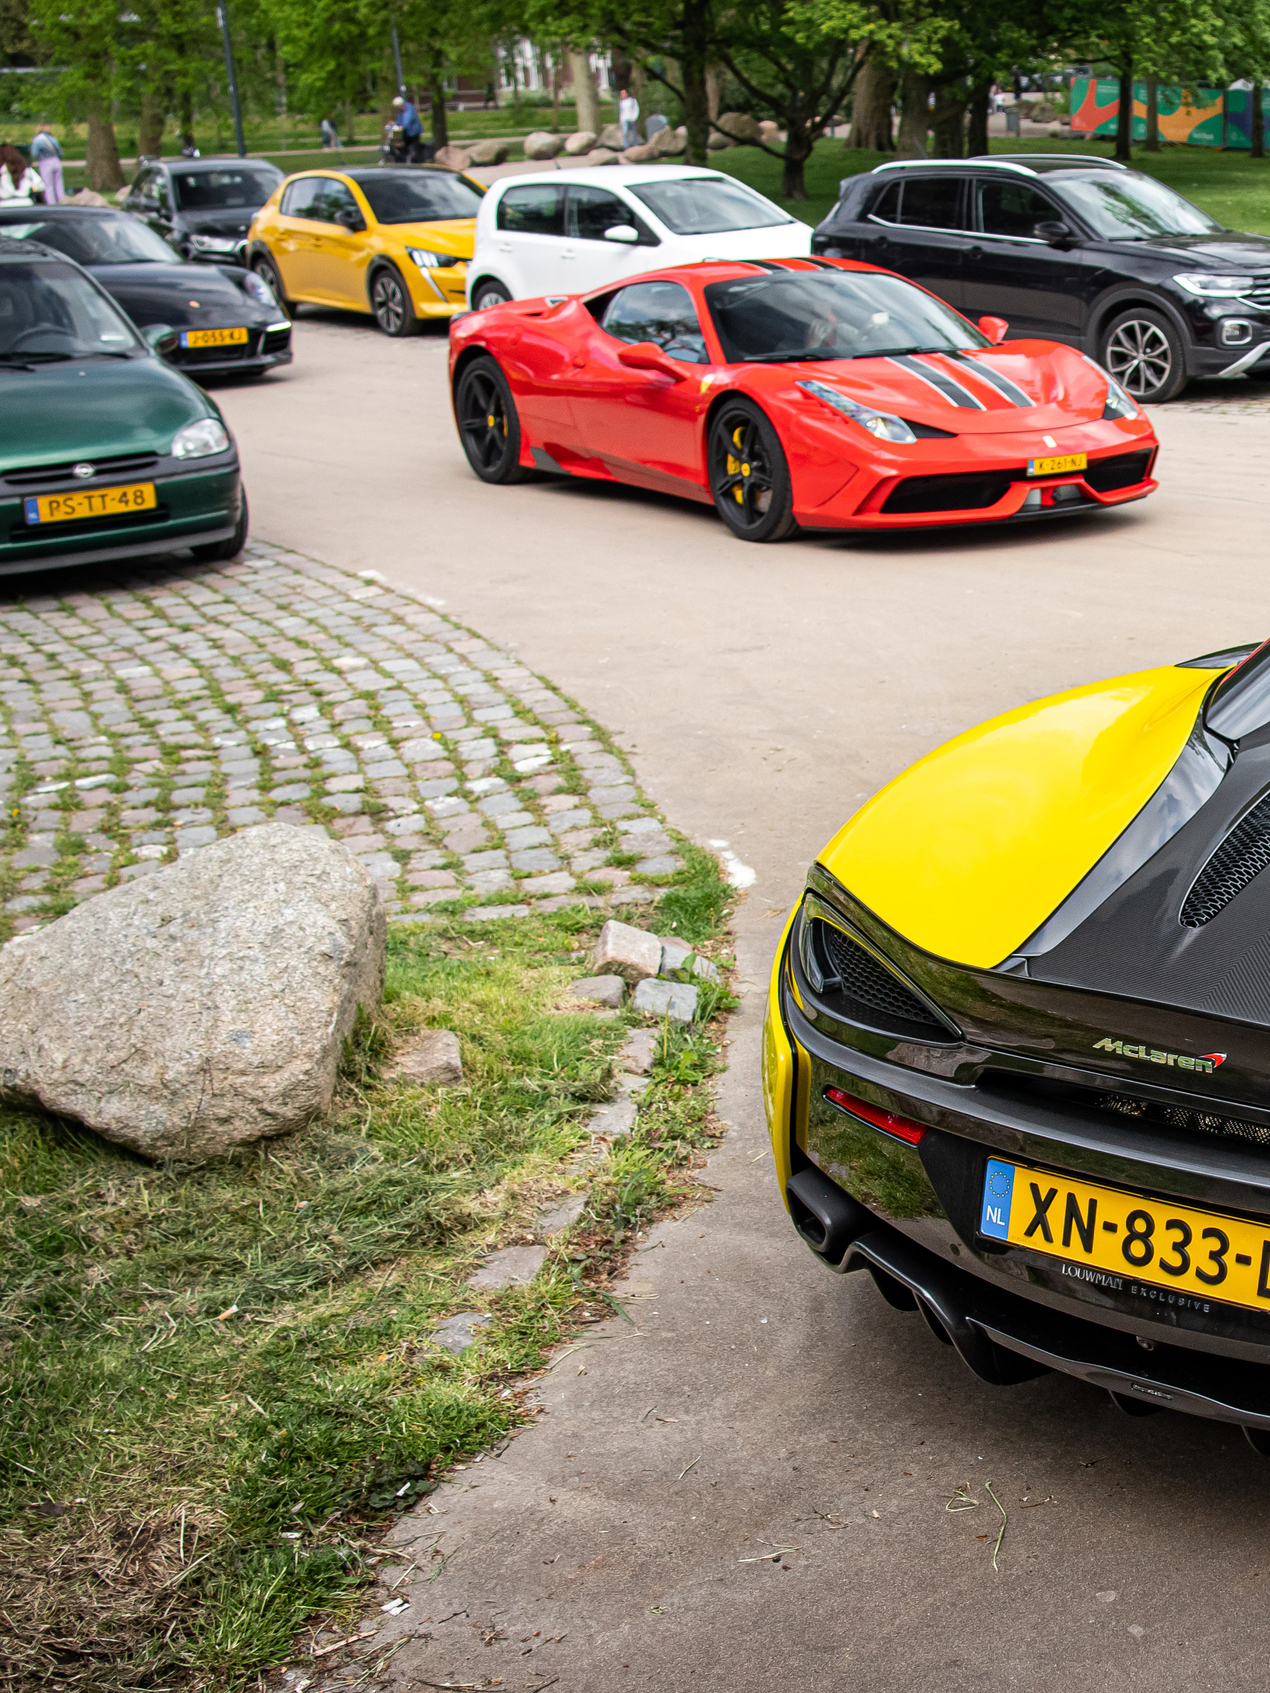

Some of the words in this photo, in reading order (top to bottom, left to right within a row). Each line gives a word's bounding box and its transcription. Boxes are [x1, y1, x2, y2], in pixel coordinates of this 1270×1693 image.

[1039, 456, 1083, 471] K-261-NJ
[48, 489, 145, 517] PS-TT-48
[1092, 1037, 1213, 1074] McLaren
[986, 1205, 1006, 1226] NL
[1062, 1264, 1123, 1291] LOUWMAN
[1131, 1285, 1211, 1313] EXCLUSIVE
